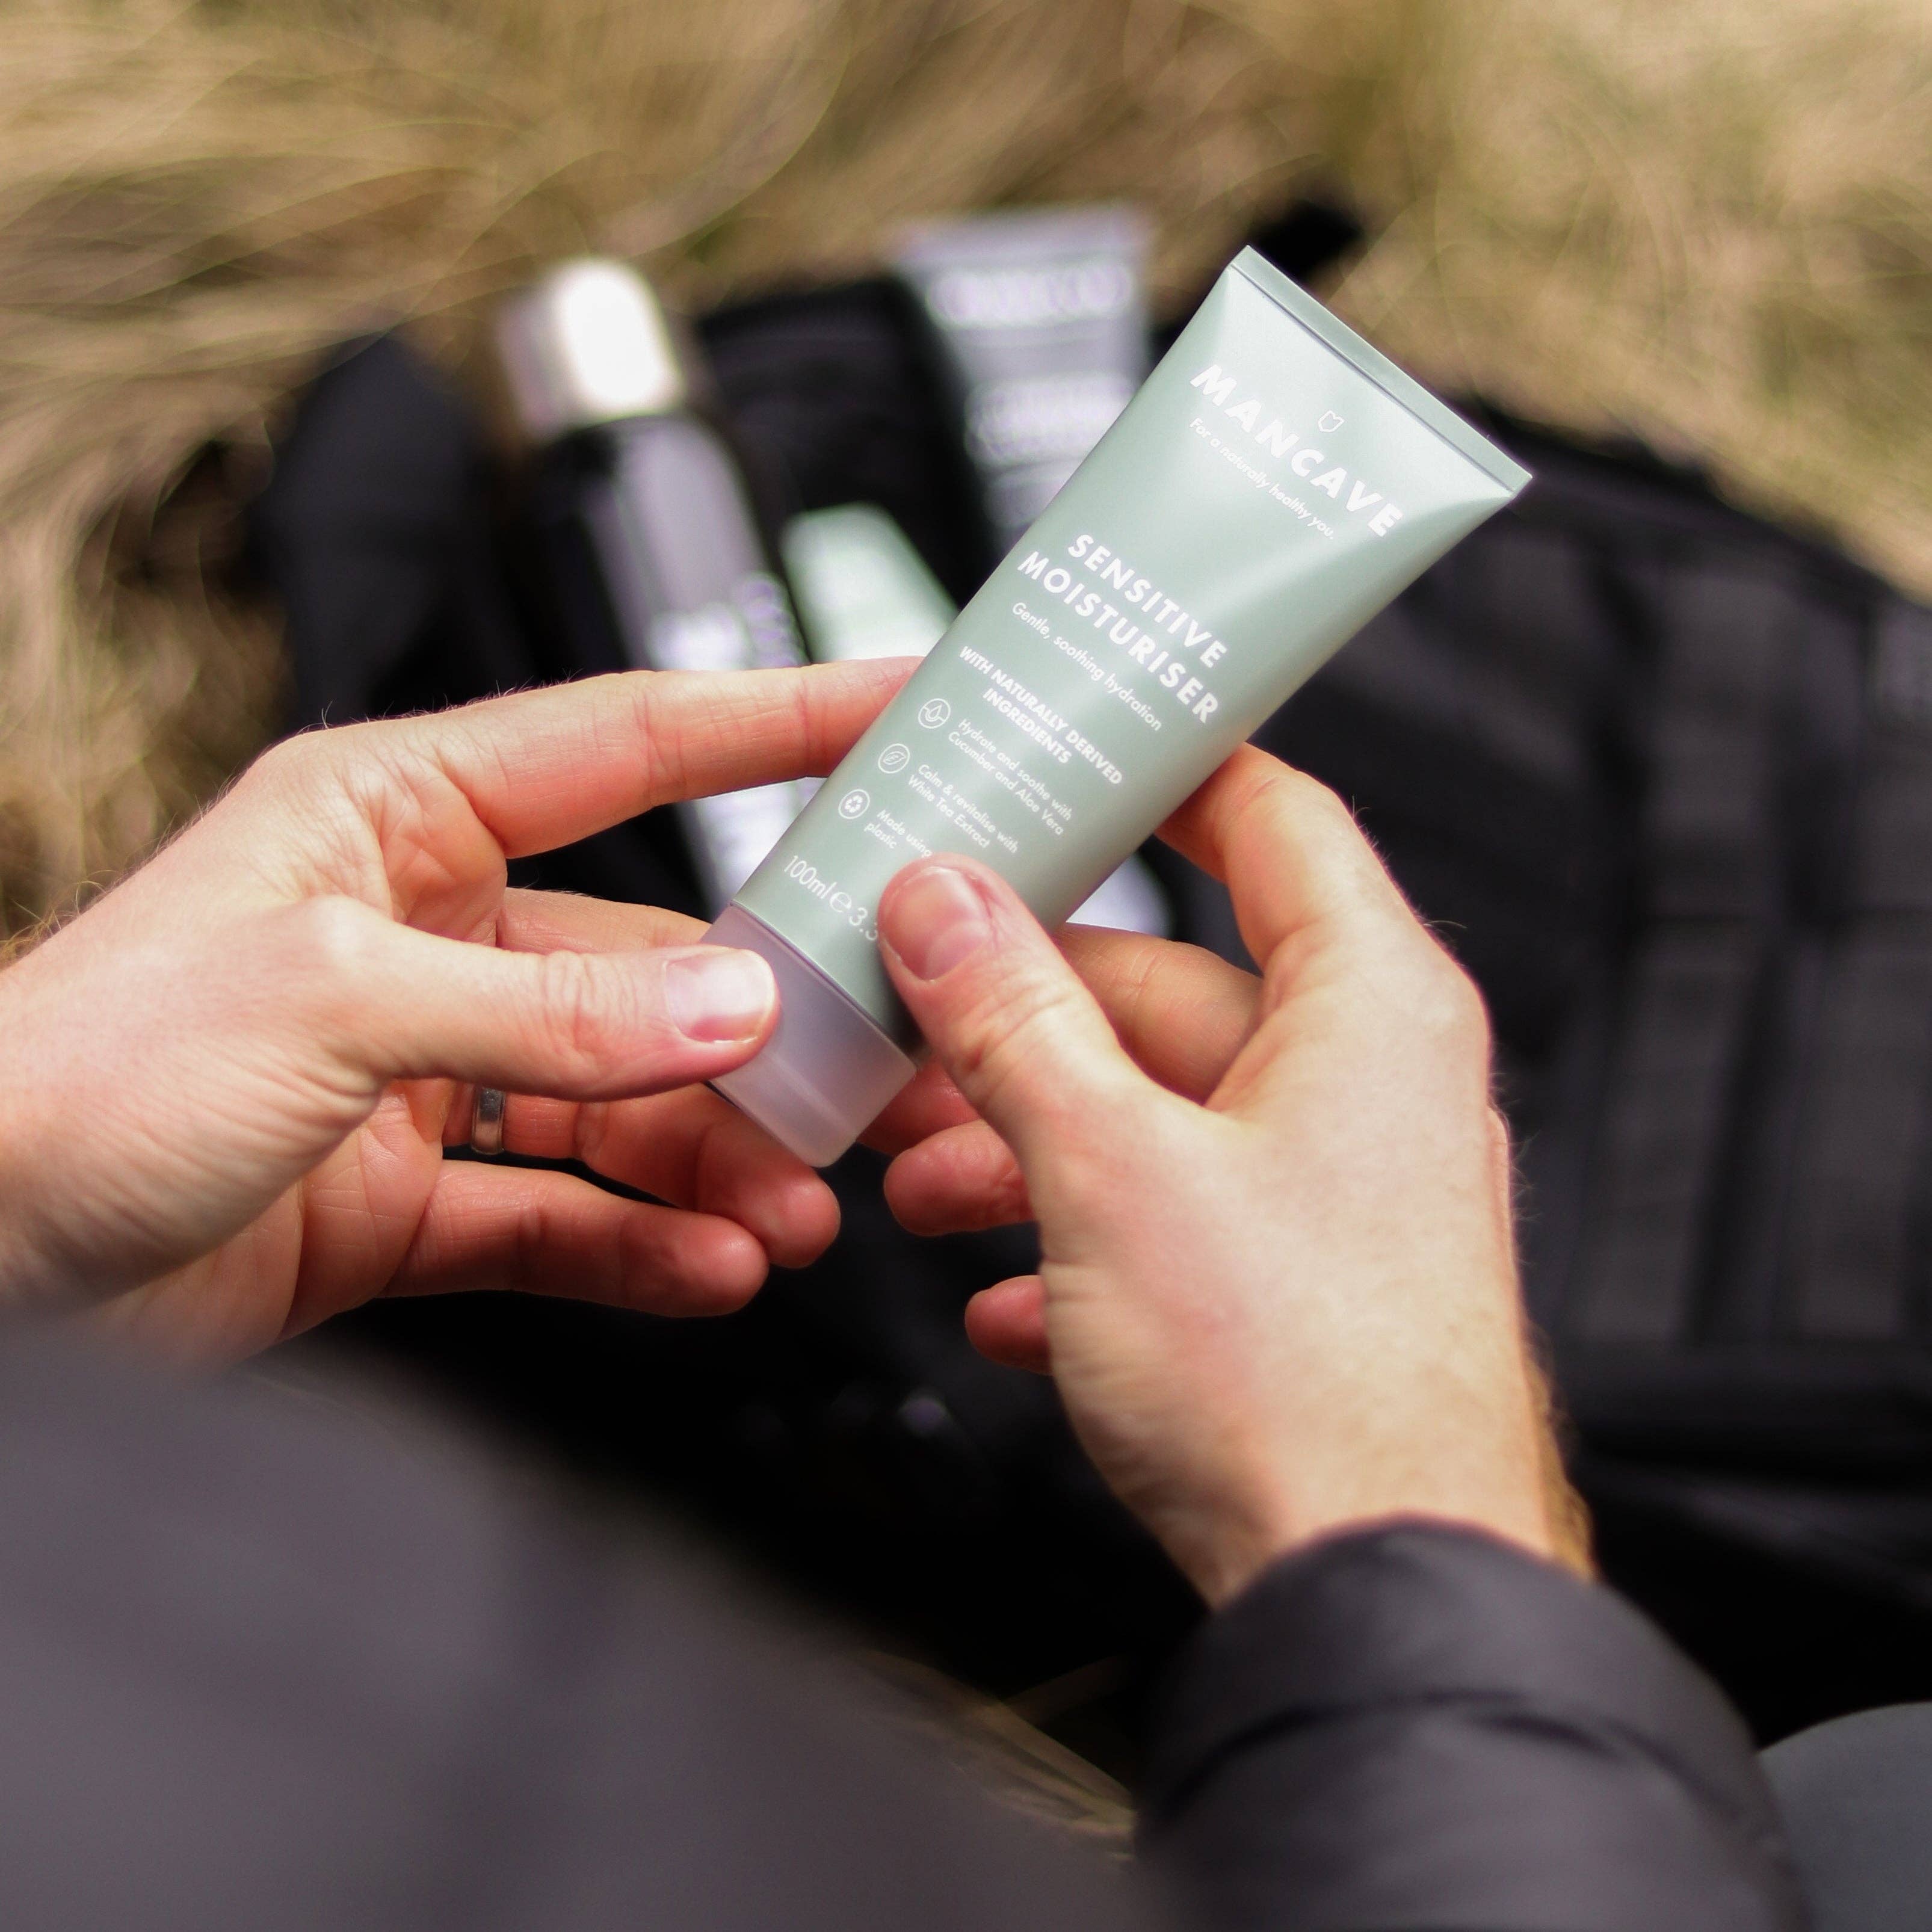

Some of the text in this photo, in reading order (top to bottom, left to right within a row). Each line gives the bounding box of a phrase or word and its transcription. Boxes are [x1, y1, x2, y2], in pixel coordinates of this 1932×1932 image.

[1190, 364, 1403, 537] MANCAVE
[1190, 418, 1334, 540] For a naturally healthy you.
[1017, 551, 1218, 723] MOISTURISER
[1067, 534, 1227, 668] SENSITIVE
[959, 646, 1123, 784] WITH NATURALLY DERIVED
[1012, 602, 1162, 731] Gentle, soothing hydration
[958, 719, 1072, 821] Hydrate and soothe with
[983, 688, 1072, 764] INGREDIENTS
[877, 809, 933, 858] Made using
[909, 774, 990, 848] White Tea Extract
[918, 764, 1018, 853] Calm & revitalise with
[948, 731, 1064, 835] Cucumber and Aloe Vera
[863, 822, 897, 849] plastic
